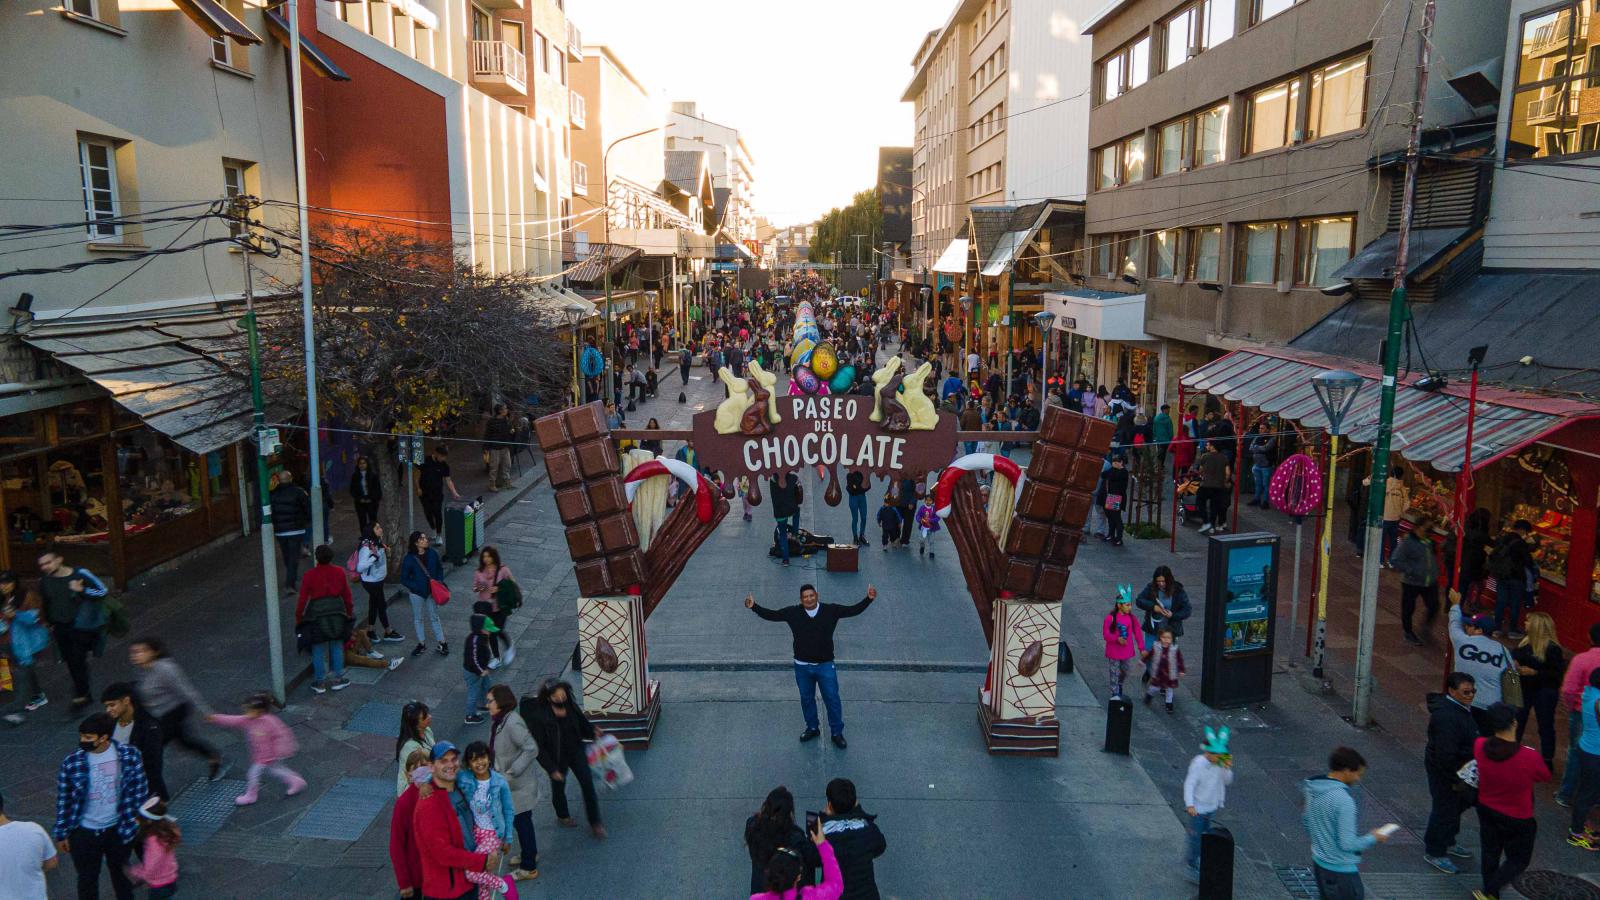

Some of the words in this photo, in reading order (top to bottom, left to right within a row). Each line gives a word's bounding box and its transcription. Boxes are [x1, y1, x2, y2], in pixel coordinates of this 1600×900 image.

[793, 397, 857, 420] PASEO
[814, 421, 834, 432] DEL
[744, 433, 906, 471] CHOCOLATE
[1458, 644, 1504, 668] God
